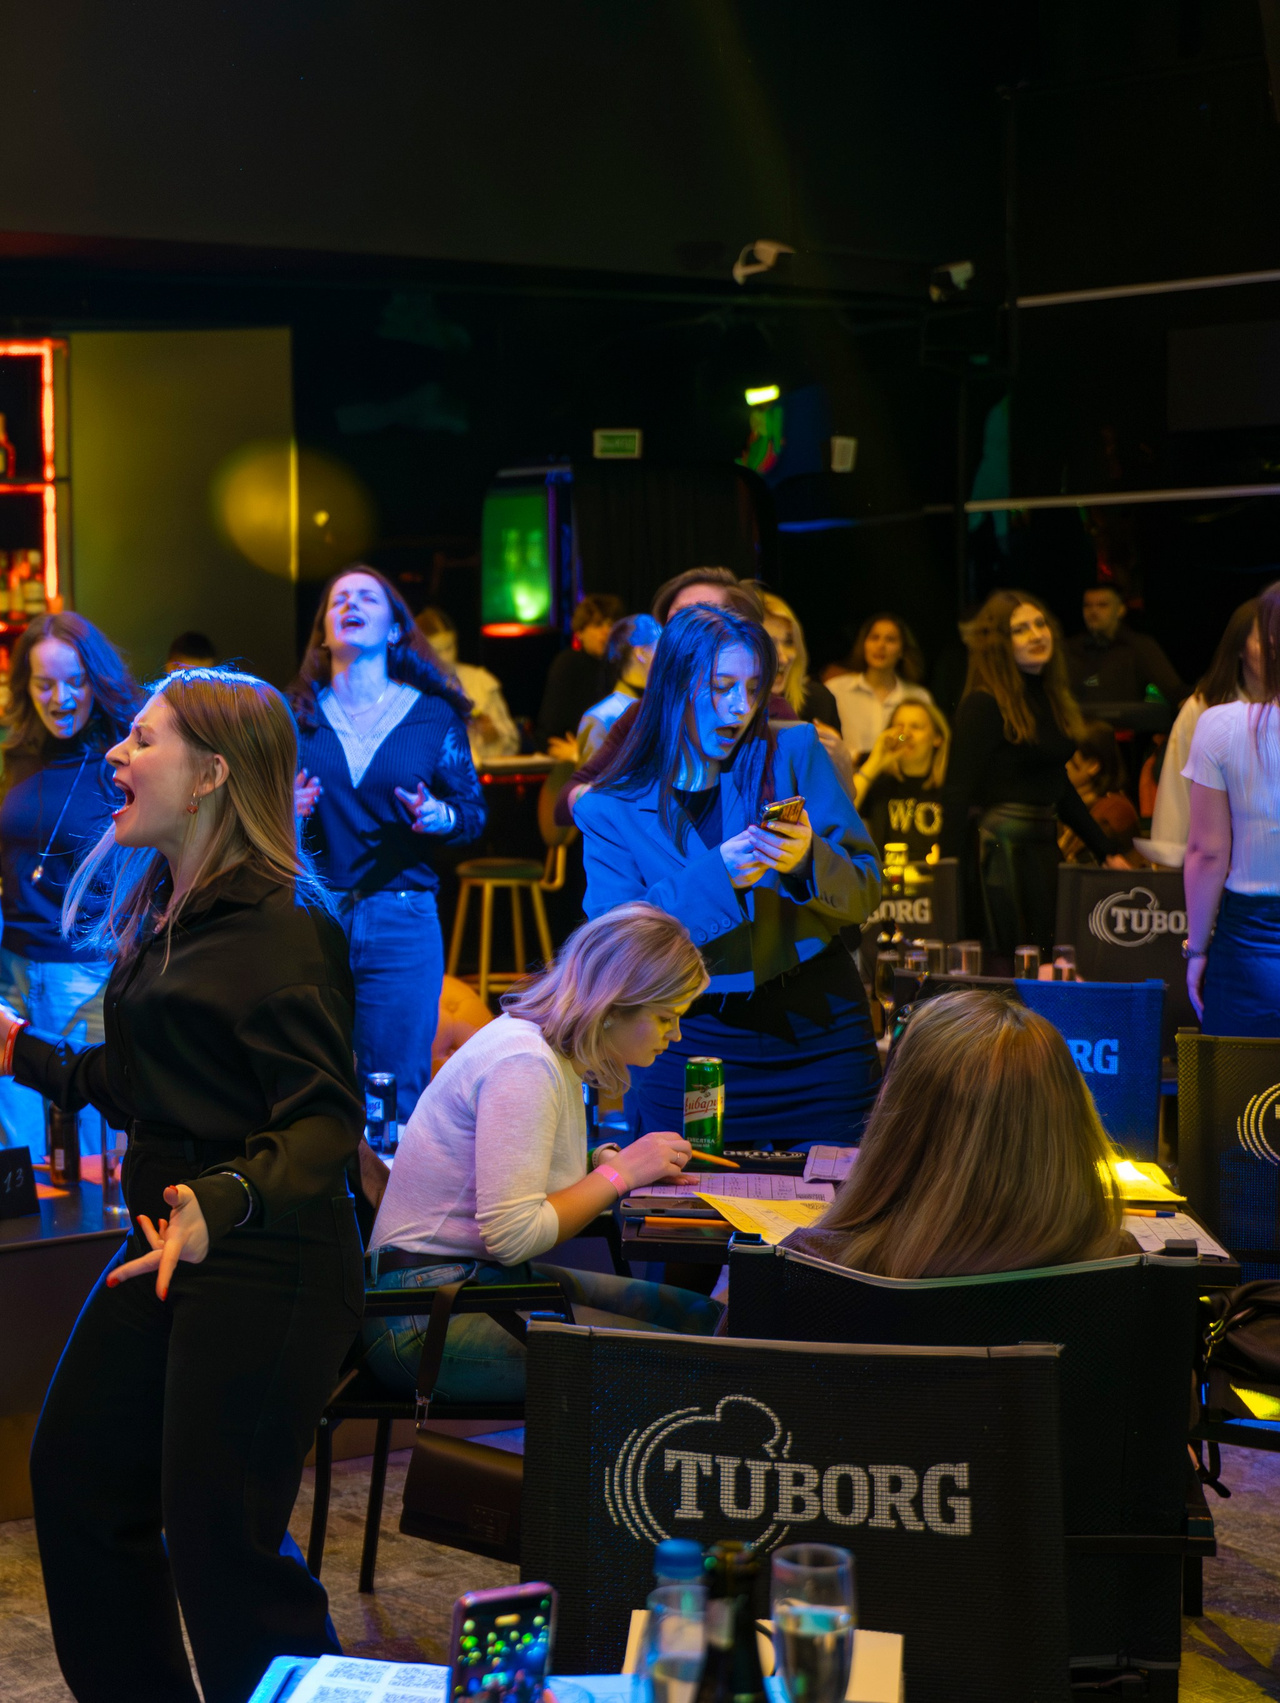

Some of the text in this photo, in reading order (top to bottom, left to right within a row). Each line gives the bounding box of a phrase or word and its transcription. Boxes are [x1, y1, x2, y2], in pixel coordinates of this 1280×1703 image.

[1110, 906, 1188, 934] TUBO
[3, 1167, 24, 1194] 13
[664, 1449, 972, 1536] TUBORG
